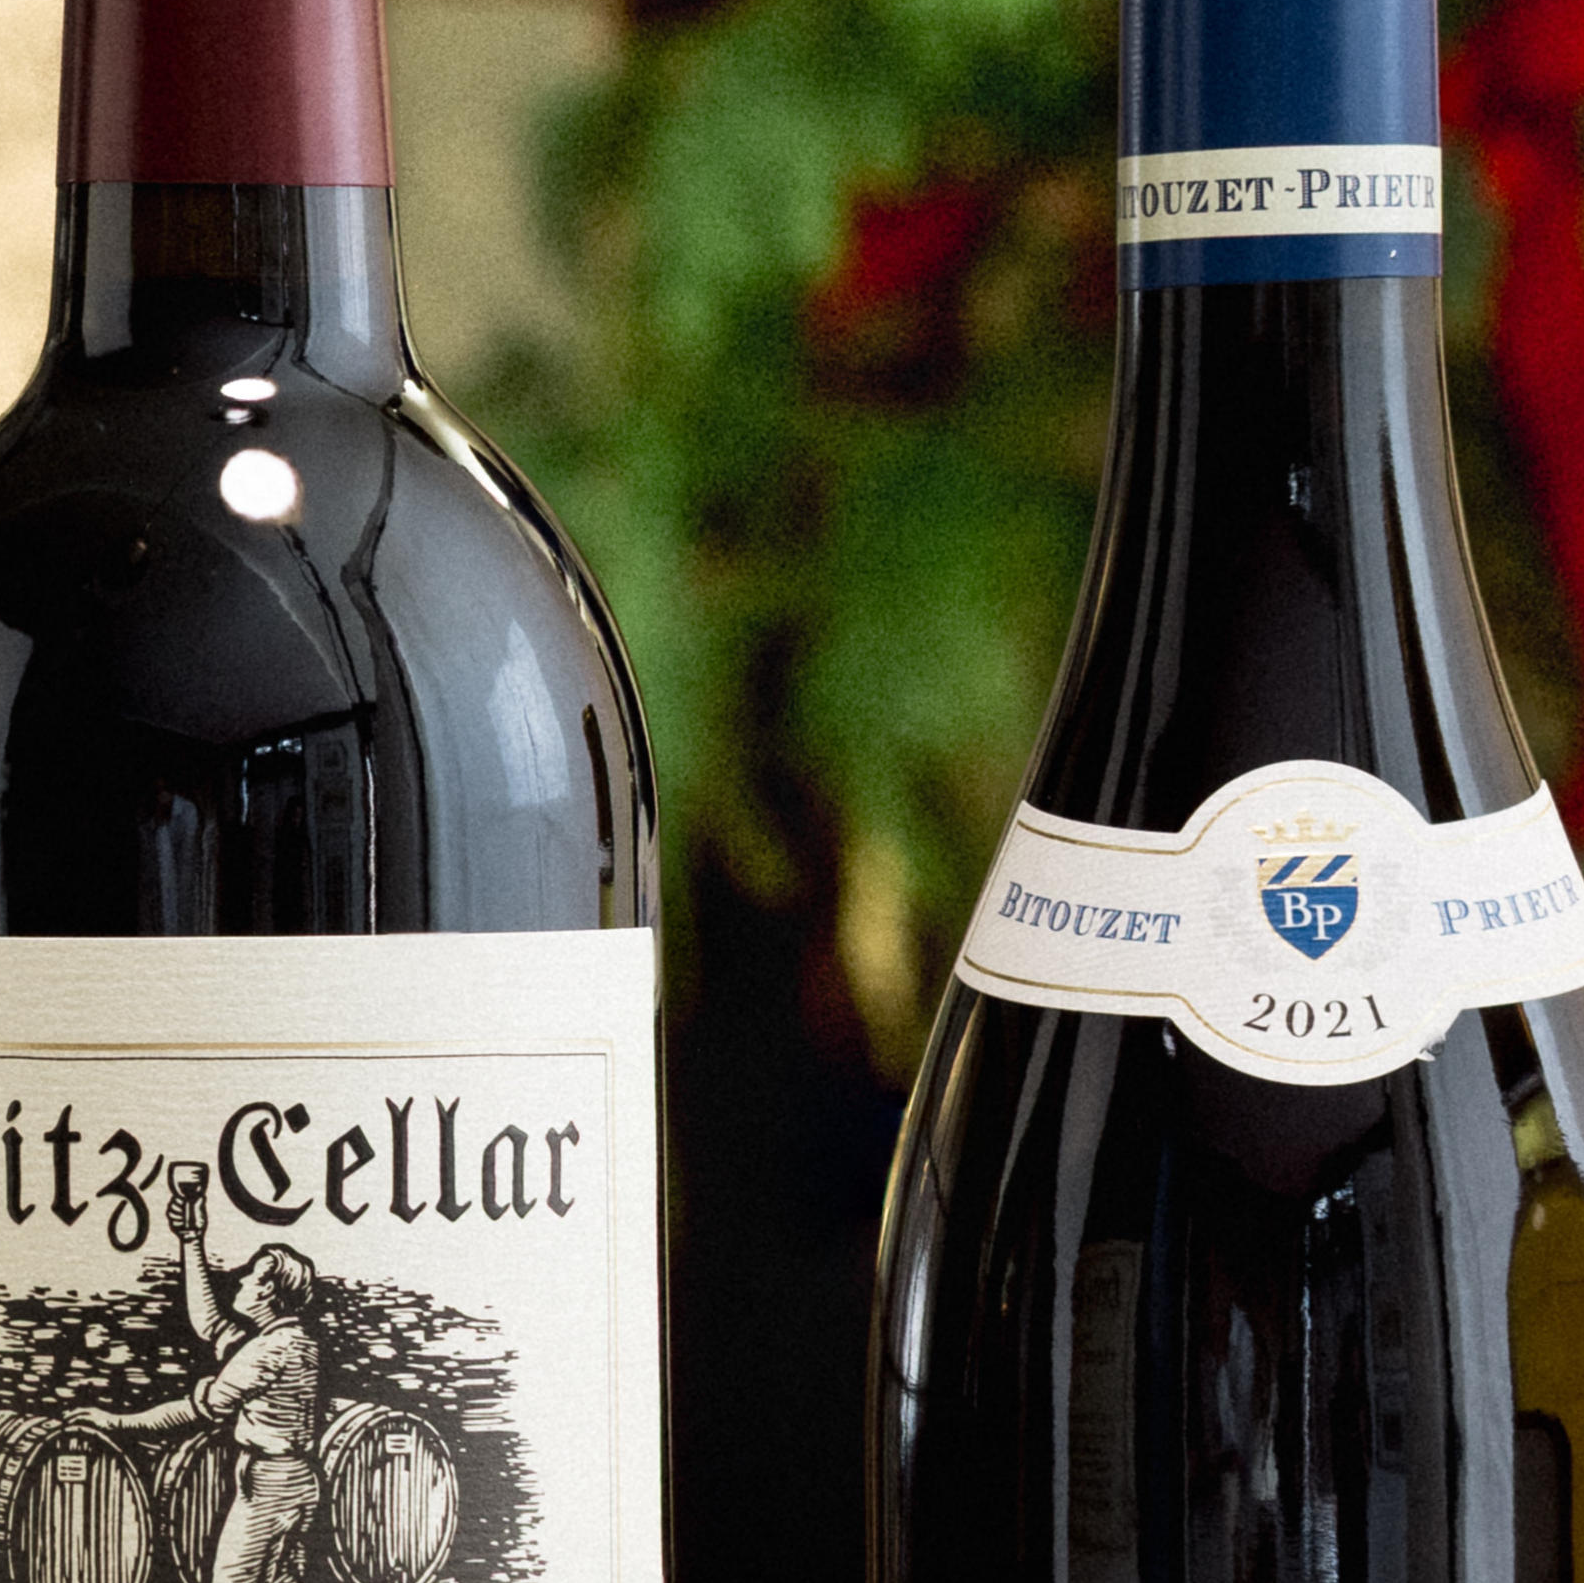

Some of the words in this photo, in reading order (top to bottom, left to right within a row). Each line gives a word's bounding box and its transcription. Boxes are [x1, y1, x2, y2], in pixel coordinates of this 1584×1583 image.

[1000, 881, 1181, 944] BITOUZET
[1276, 893, 1341, 941] BP
[1431, 873, 1581, 937] PRIEUR
[1242, 992, 1390, 1038] 2021
[217, 1097, 580, 1227] Cellar
